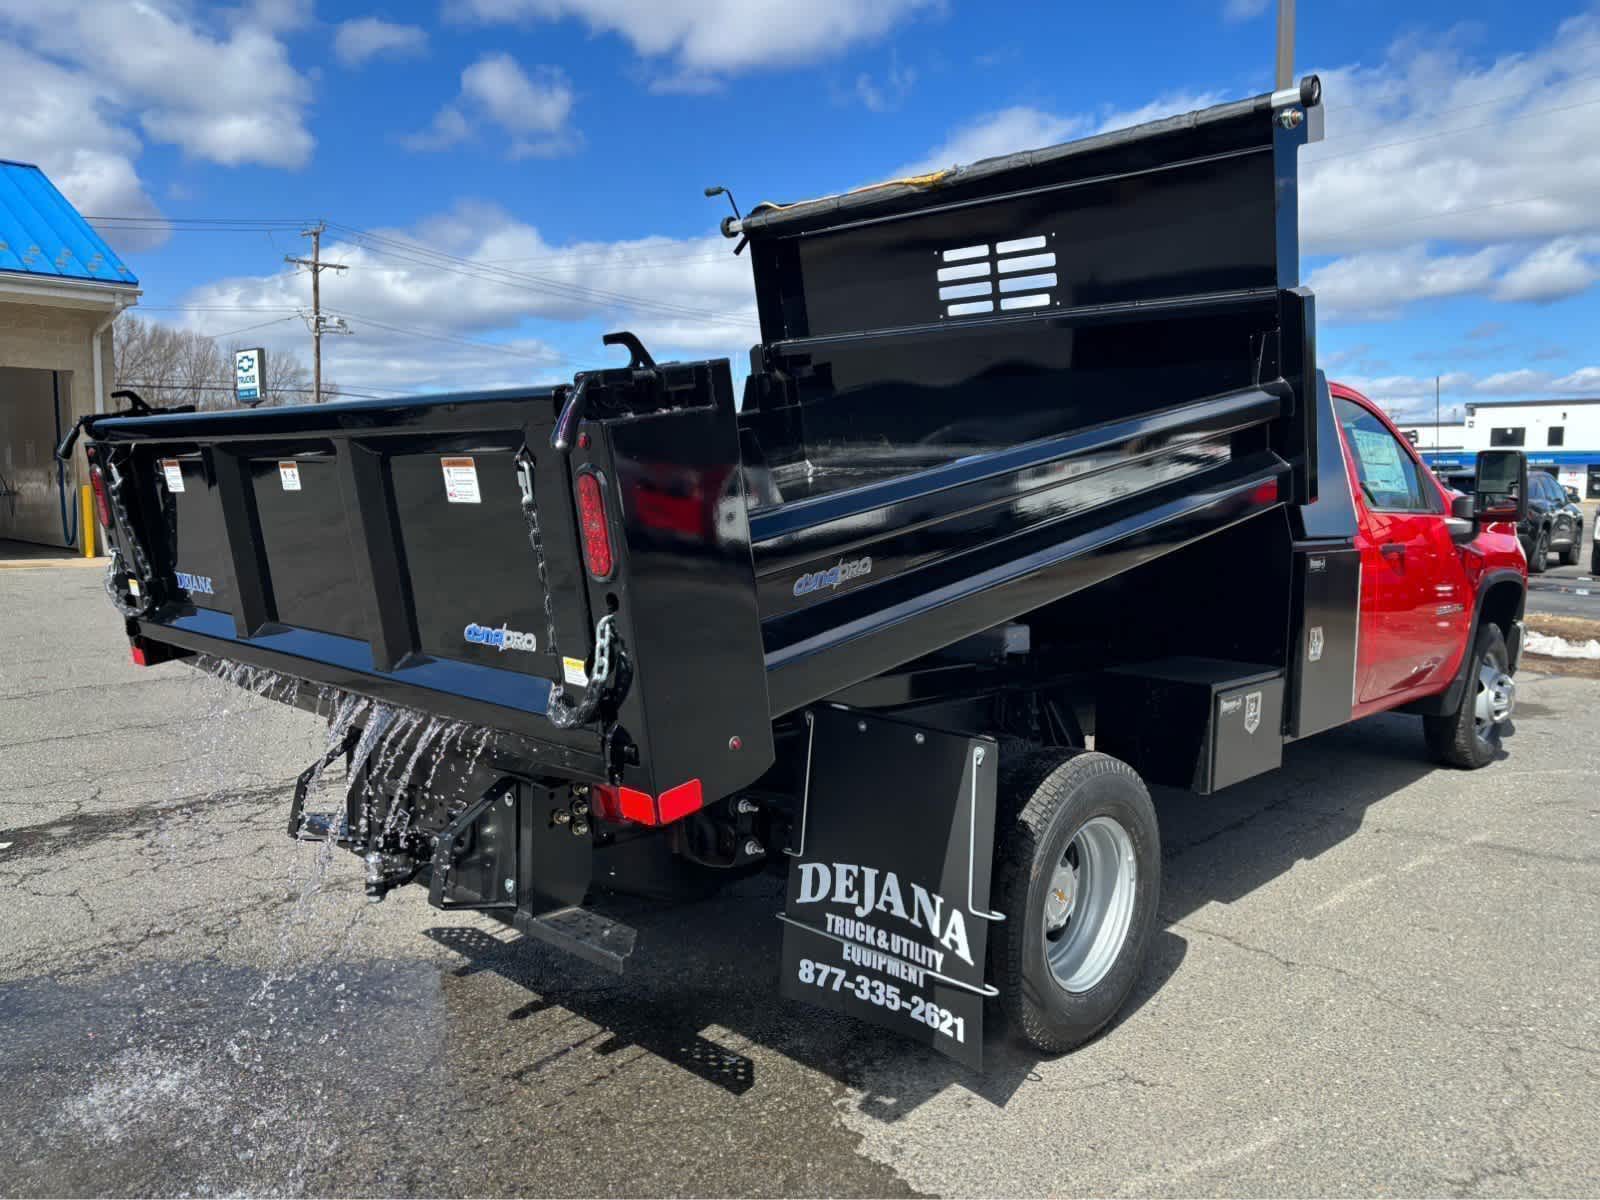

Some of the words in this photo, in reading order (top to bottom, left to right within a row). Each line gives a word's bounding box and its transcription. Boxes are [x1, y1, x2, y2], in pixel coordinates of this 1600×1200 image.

[796, 863, 975, 966] DEJANA
[825, 912, 875, 946] TRUCK
[877, 929, 889, 951] &
[891, 932, 945, 973] UTILITY
[798, 958, 965, 1043] 877-335-2621
[842, 942, 926, 988] EQUIPMENT
